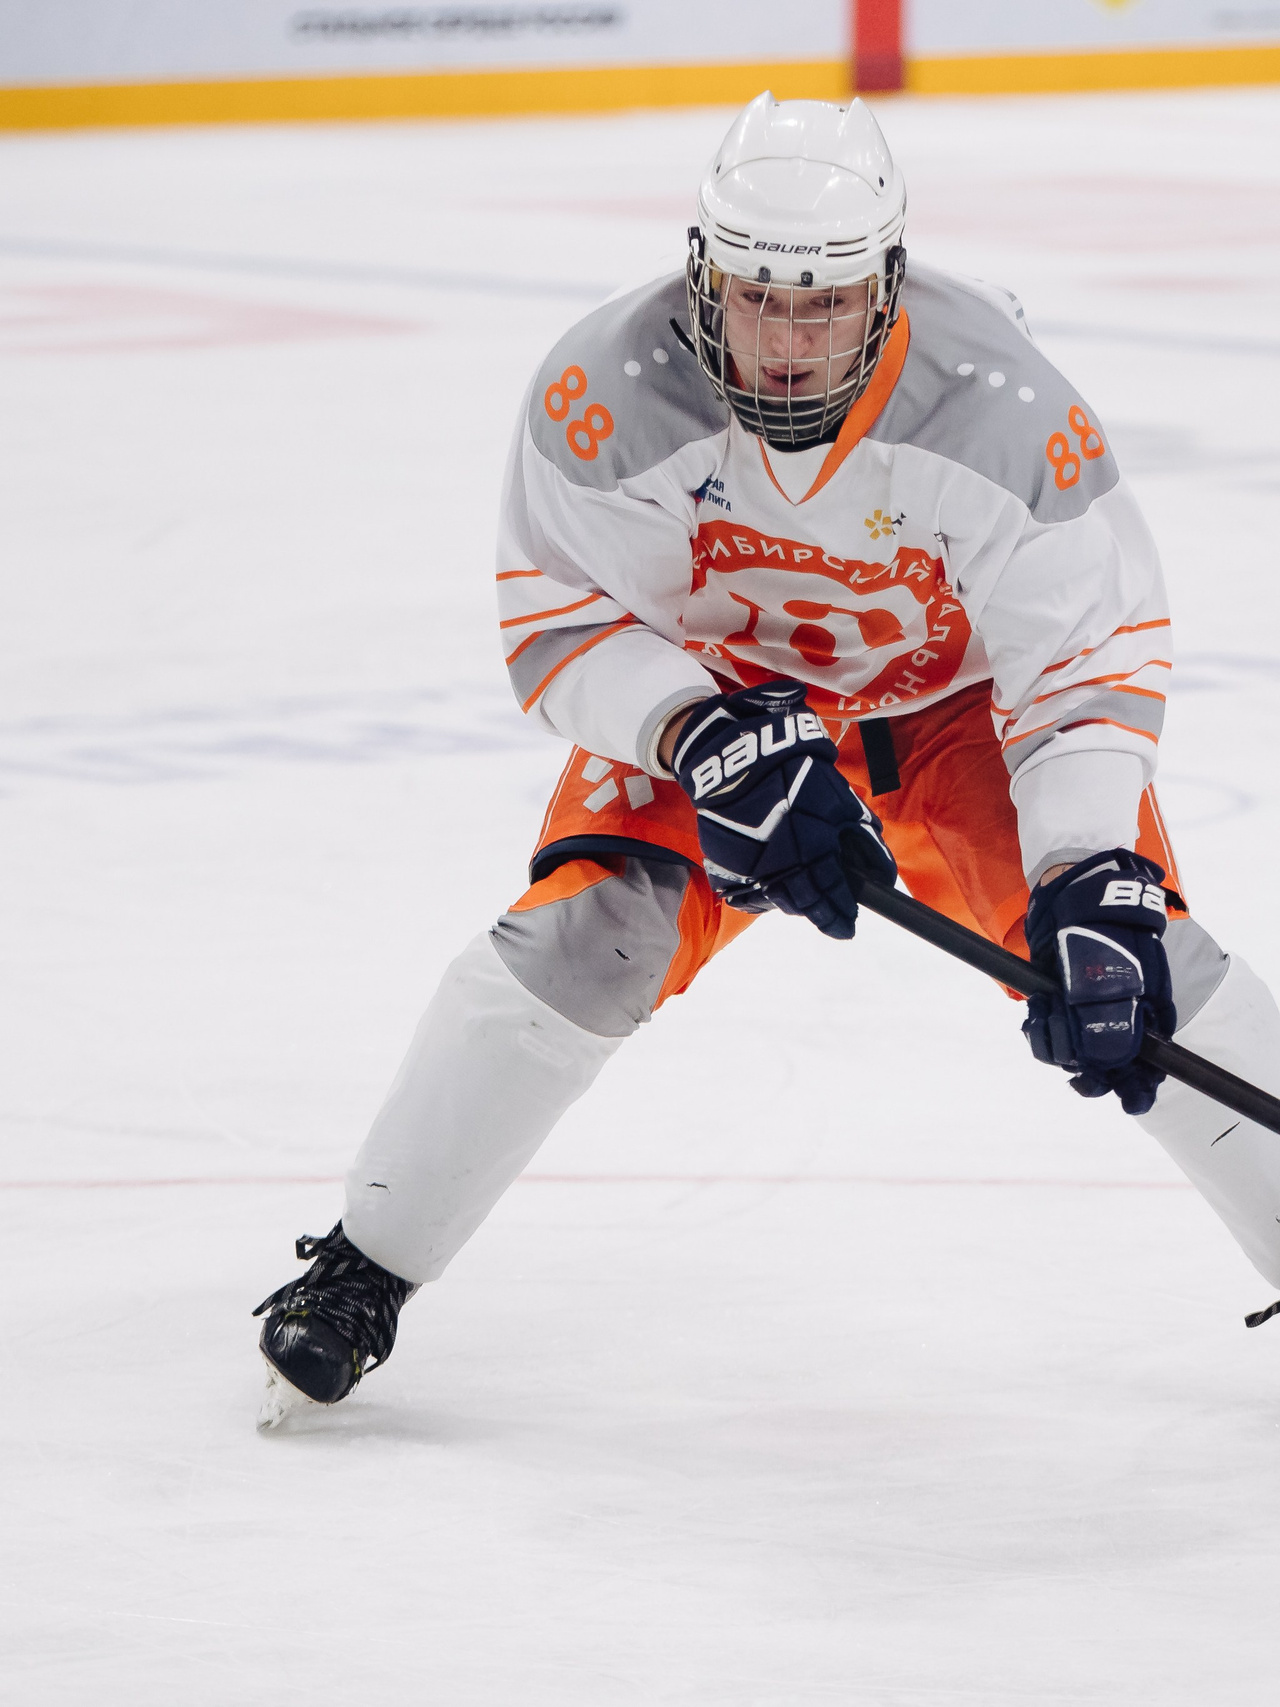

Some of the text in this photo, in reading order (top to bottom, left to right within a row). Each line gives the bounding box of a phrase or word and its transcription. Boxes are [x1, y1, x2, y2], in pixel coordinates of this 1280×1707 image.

[752, 241, 822, 256] BAUER
[544, 365, 615, 461] 88
[1046, 405, 1105, 491] 88
[691, 712, 829, 800] BAUE
